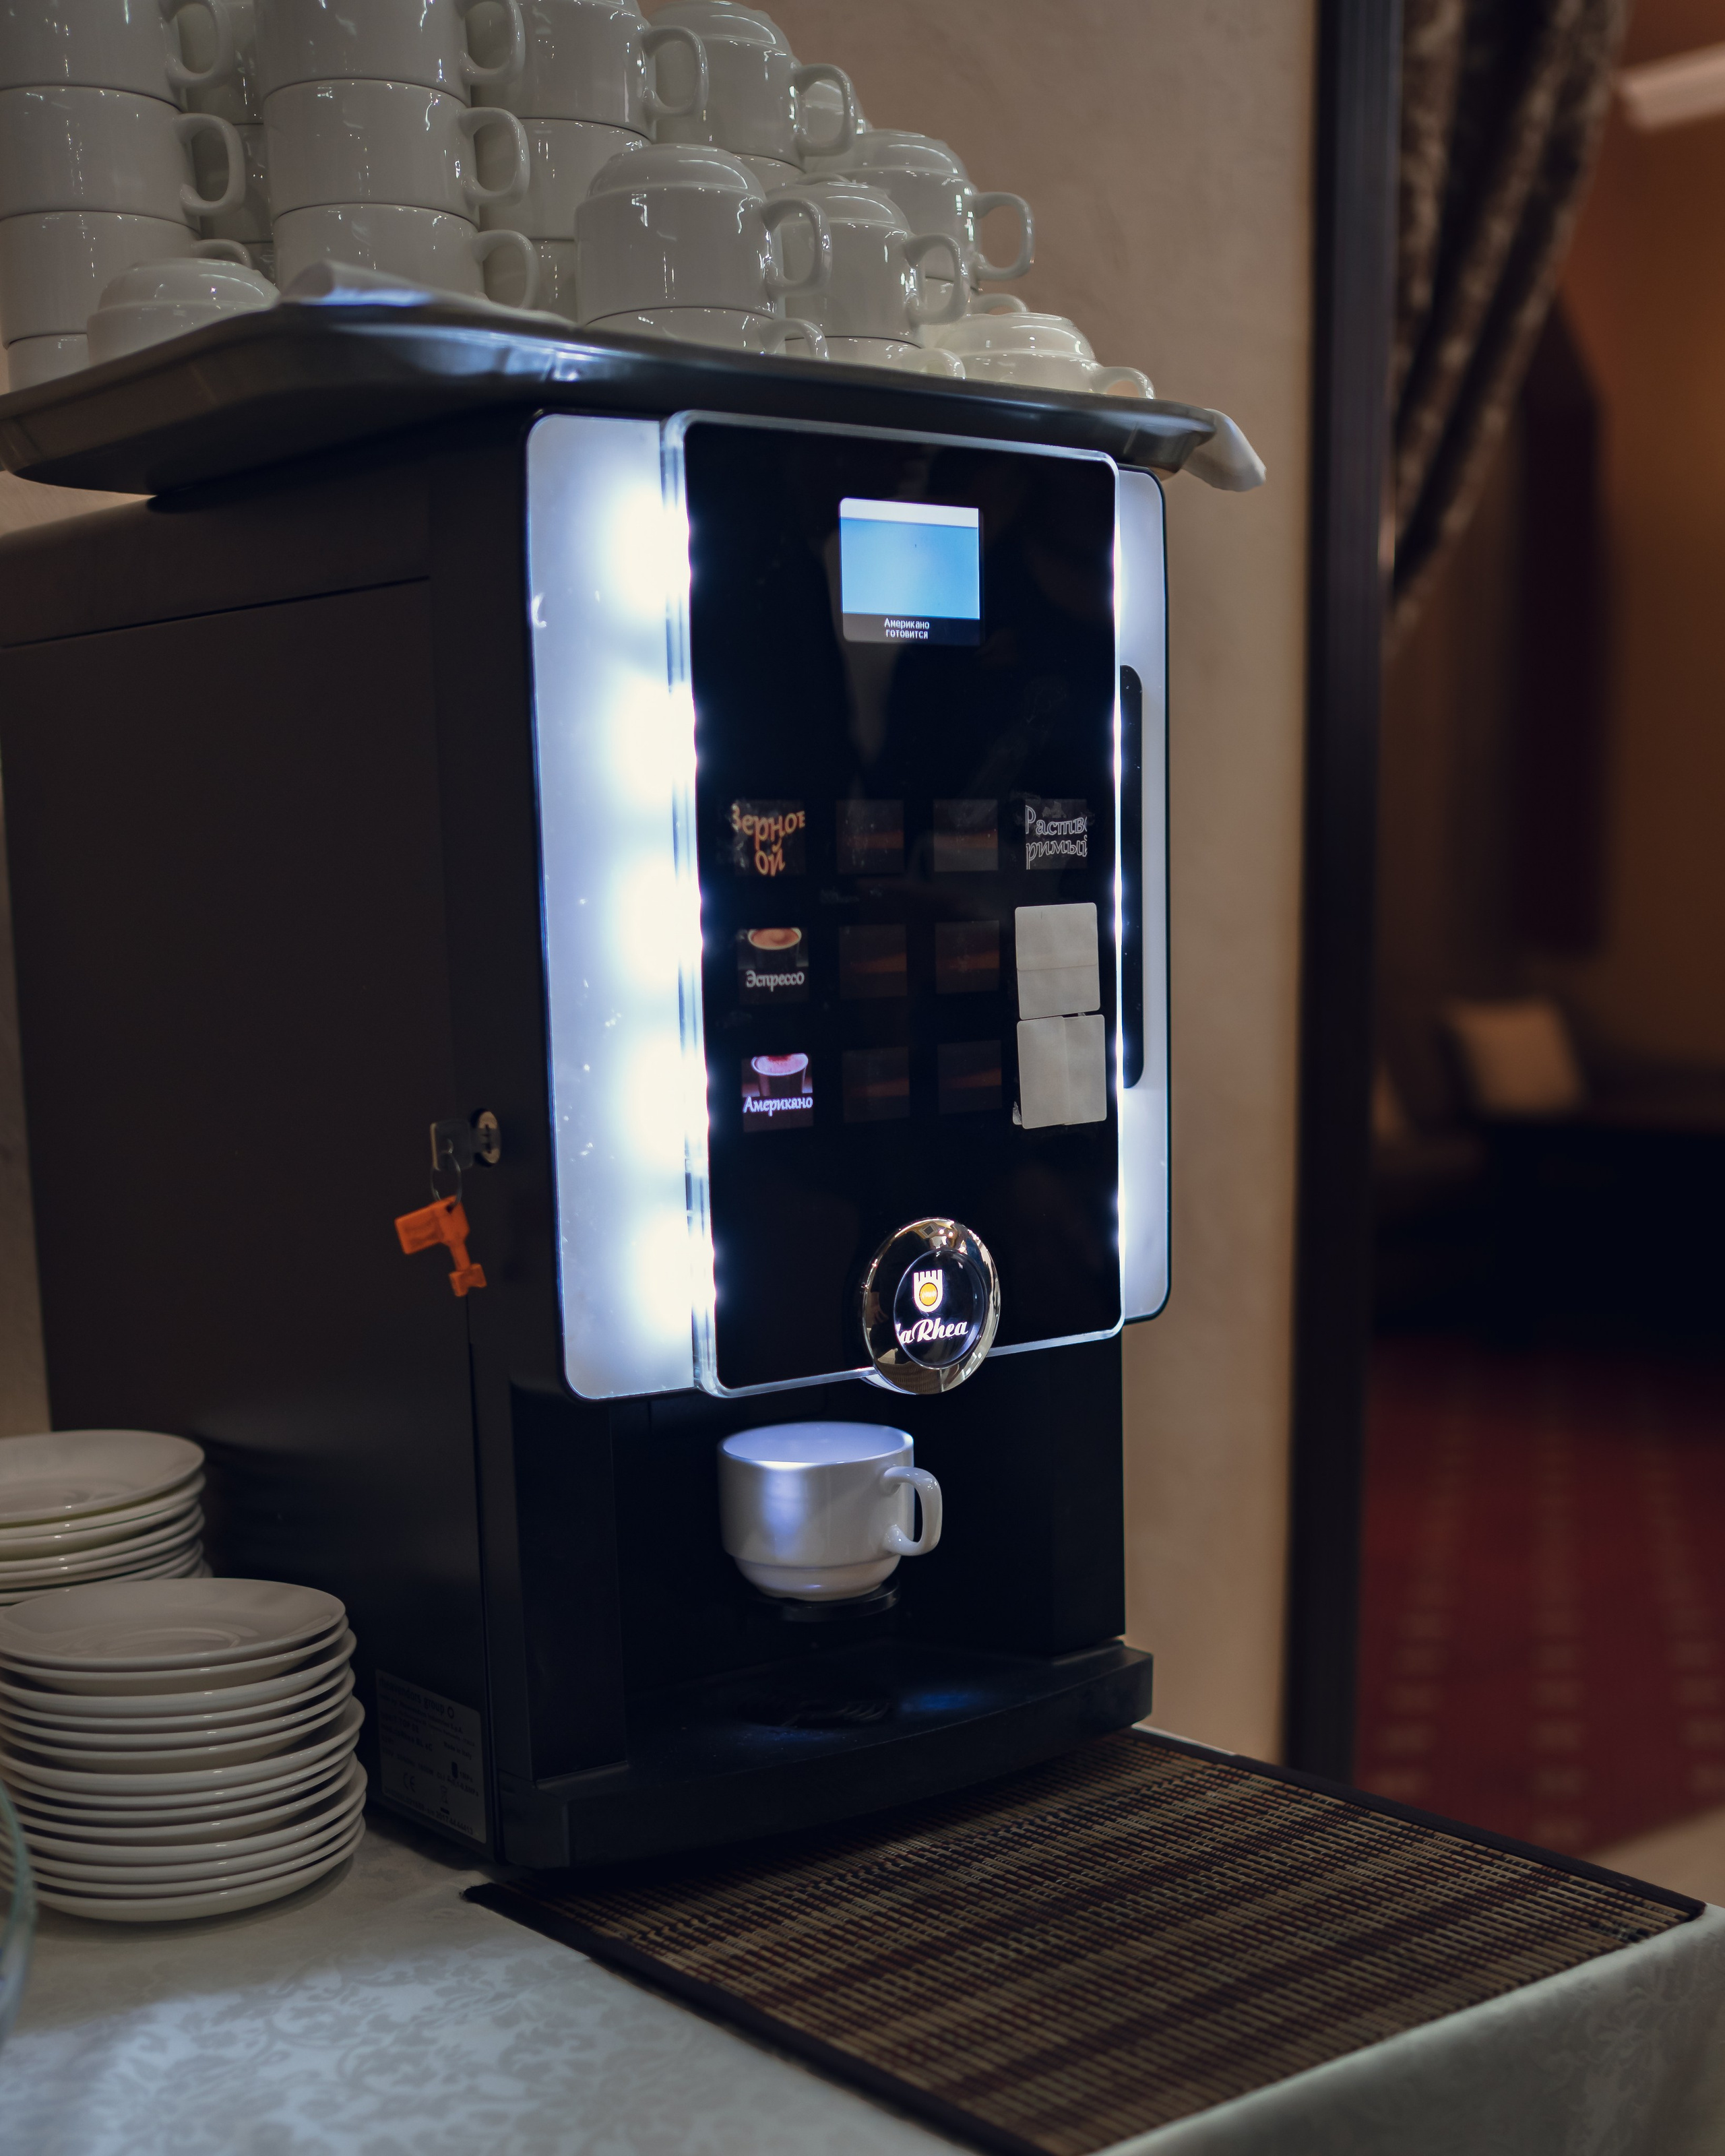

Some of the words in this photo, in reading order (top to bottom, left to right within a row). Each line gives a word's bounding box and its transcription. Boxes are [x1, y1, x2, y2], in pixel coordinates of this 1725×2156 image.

[884, 618, 930, 629] Американо
[886, 629, 929, 639] готовится
[1026, 805, 1087, 835] Раств
[745, 970, 805, 992] Эспрессо
[743, 1096, 813, 1116] Американо
[423, 1697, 445, 1715] group
